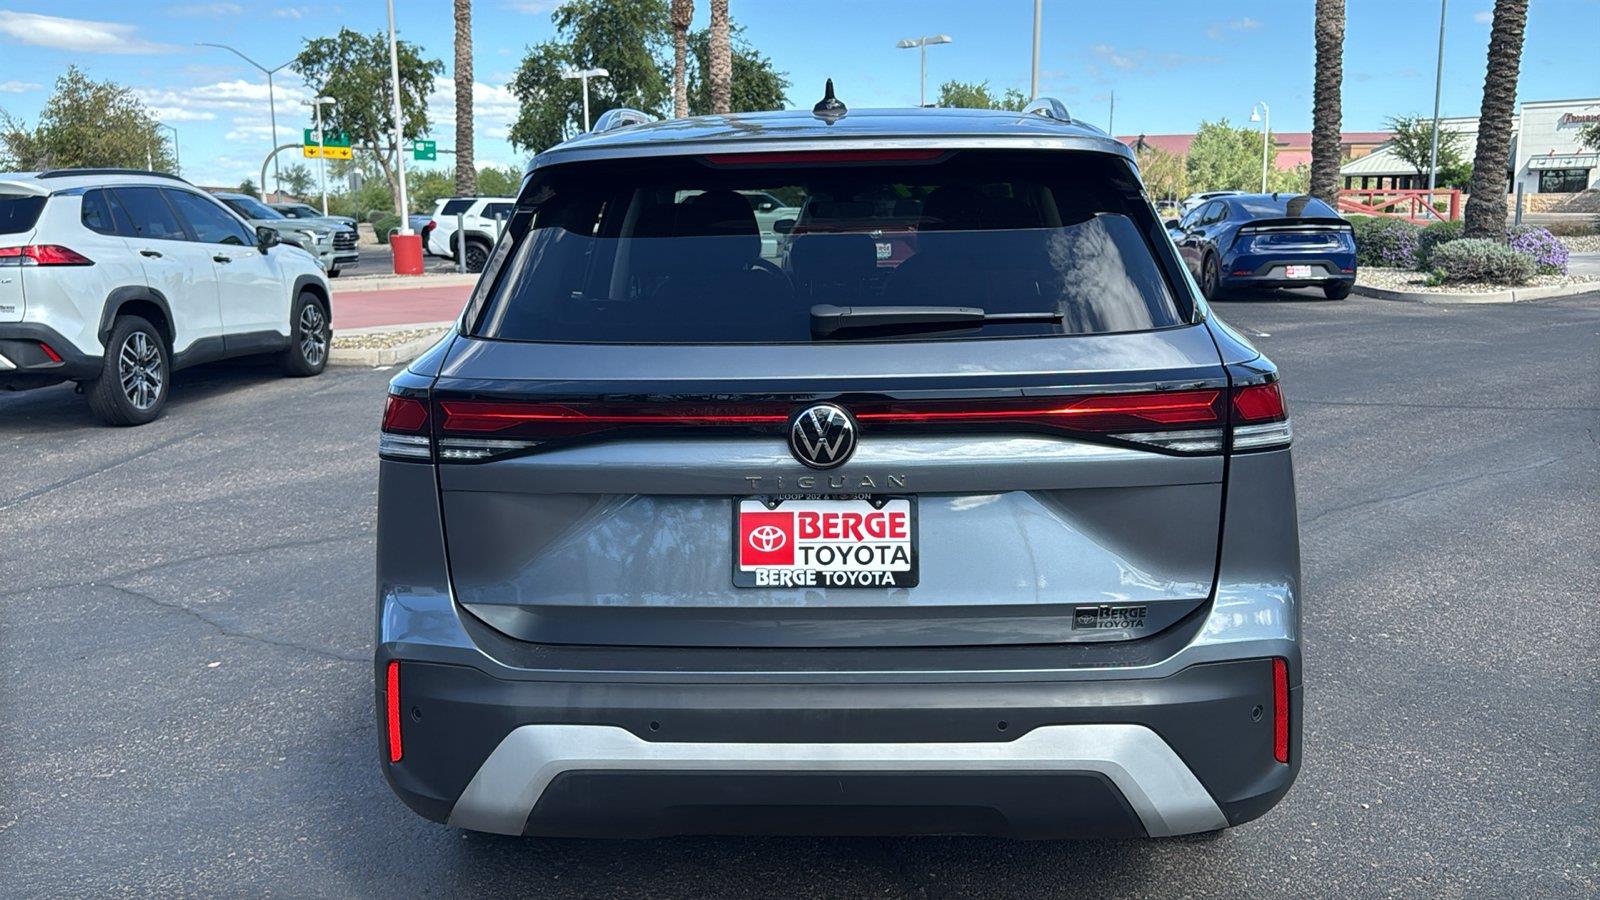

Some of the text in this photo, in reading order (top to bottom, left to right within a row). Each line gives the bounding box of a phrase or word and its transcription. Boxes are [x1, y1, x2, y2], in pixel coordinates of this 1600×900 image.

[745, 475, 905, 488] TIGUAN
[798, 511, 907, 542] BERGE
[798, 545, 910, 565] TOYOTA
[755, 568, 896, 587] BERGE TOYOTA
[1100, 606, 1147, 619] BERGE
[1099, 620, 1144, 628] TOYOTA
